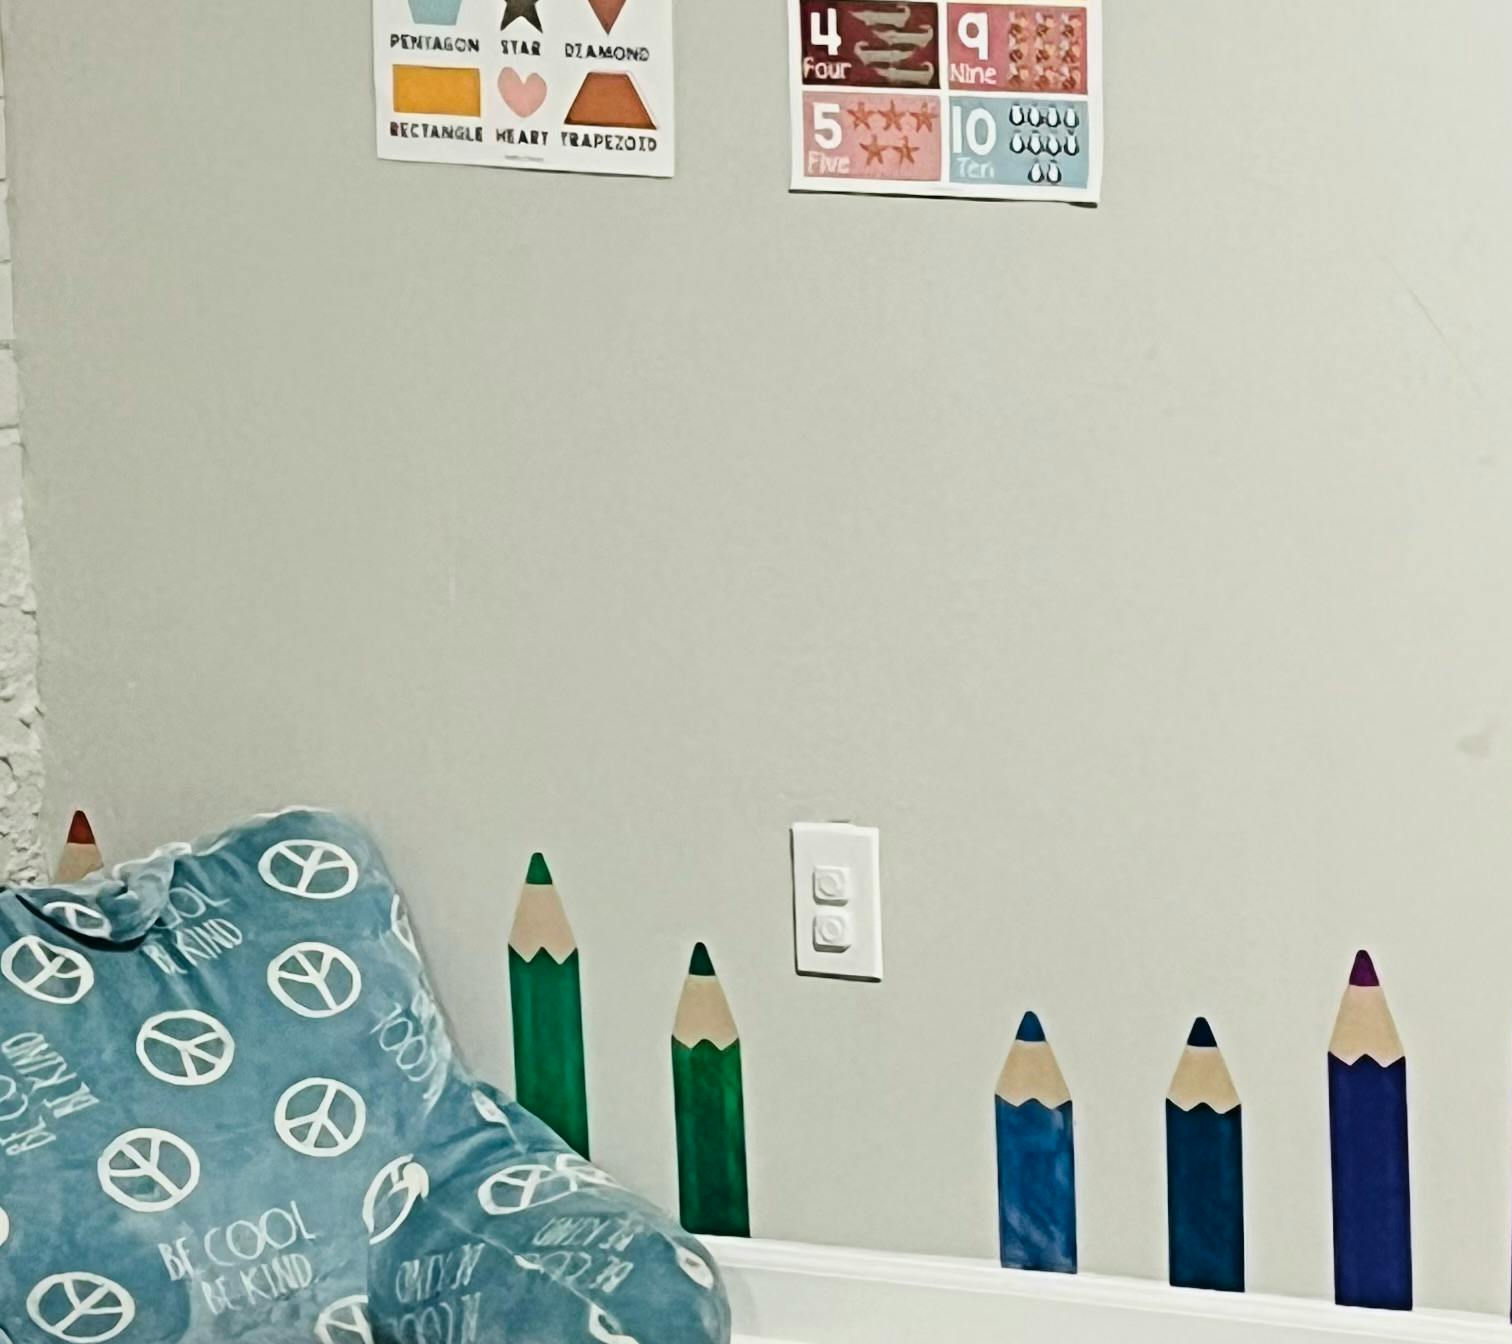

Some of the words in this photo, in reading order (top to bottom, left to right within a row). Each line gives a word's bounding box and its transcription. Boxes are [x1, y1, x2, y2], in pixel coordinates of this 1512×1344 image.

[390, 34, 479, 53] PENTAGON
[810, 8, 841, 56] 4
[958, 13, 989, 61] 9
[500, 40, 541, 57] STAR
[565, 43, 649, 61] DIAMOND
[802, 58, 851, 81] Four
[390, 121, 484, 142] RECTANGLE
[496, 128, 549, 146] HEART
[812, 103, 842, 150] 5
[951, 105, 996, 156] 10
[560, 133, 658, 153] TRAPEZOID
[157, 1238, 196, 1282] BE
[203, 1200, 316, 1261] COOL
[201, 1279, 241, 1316] BE
